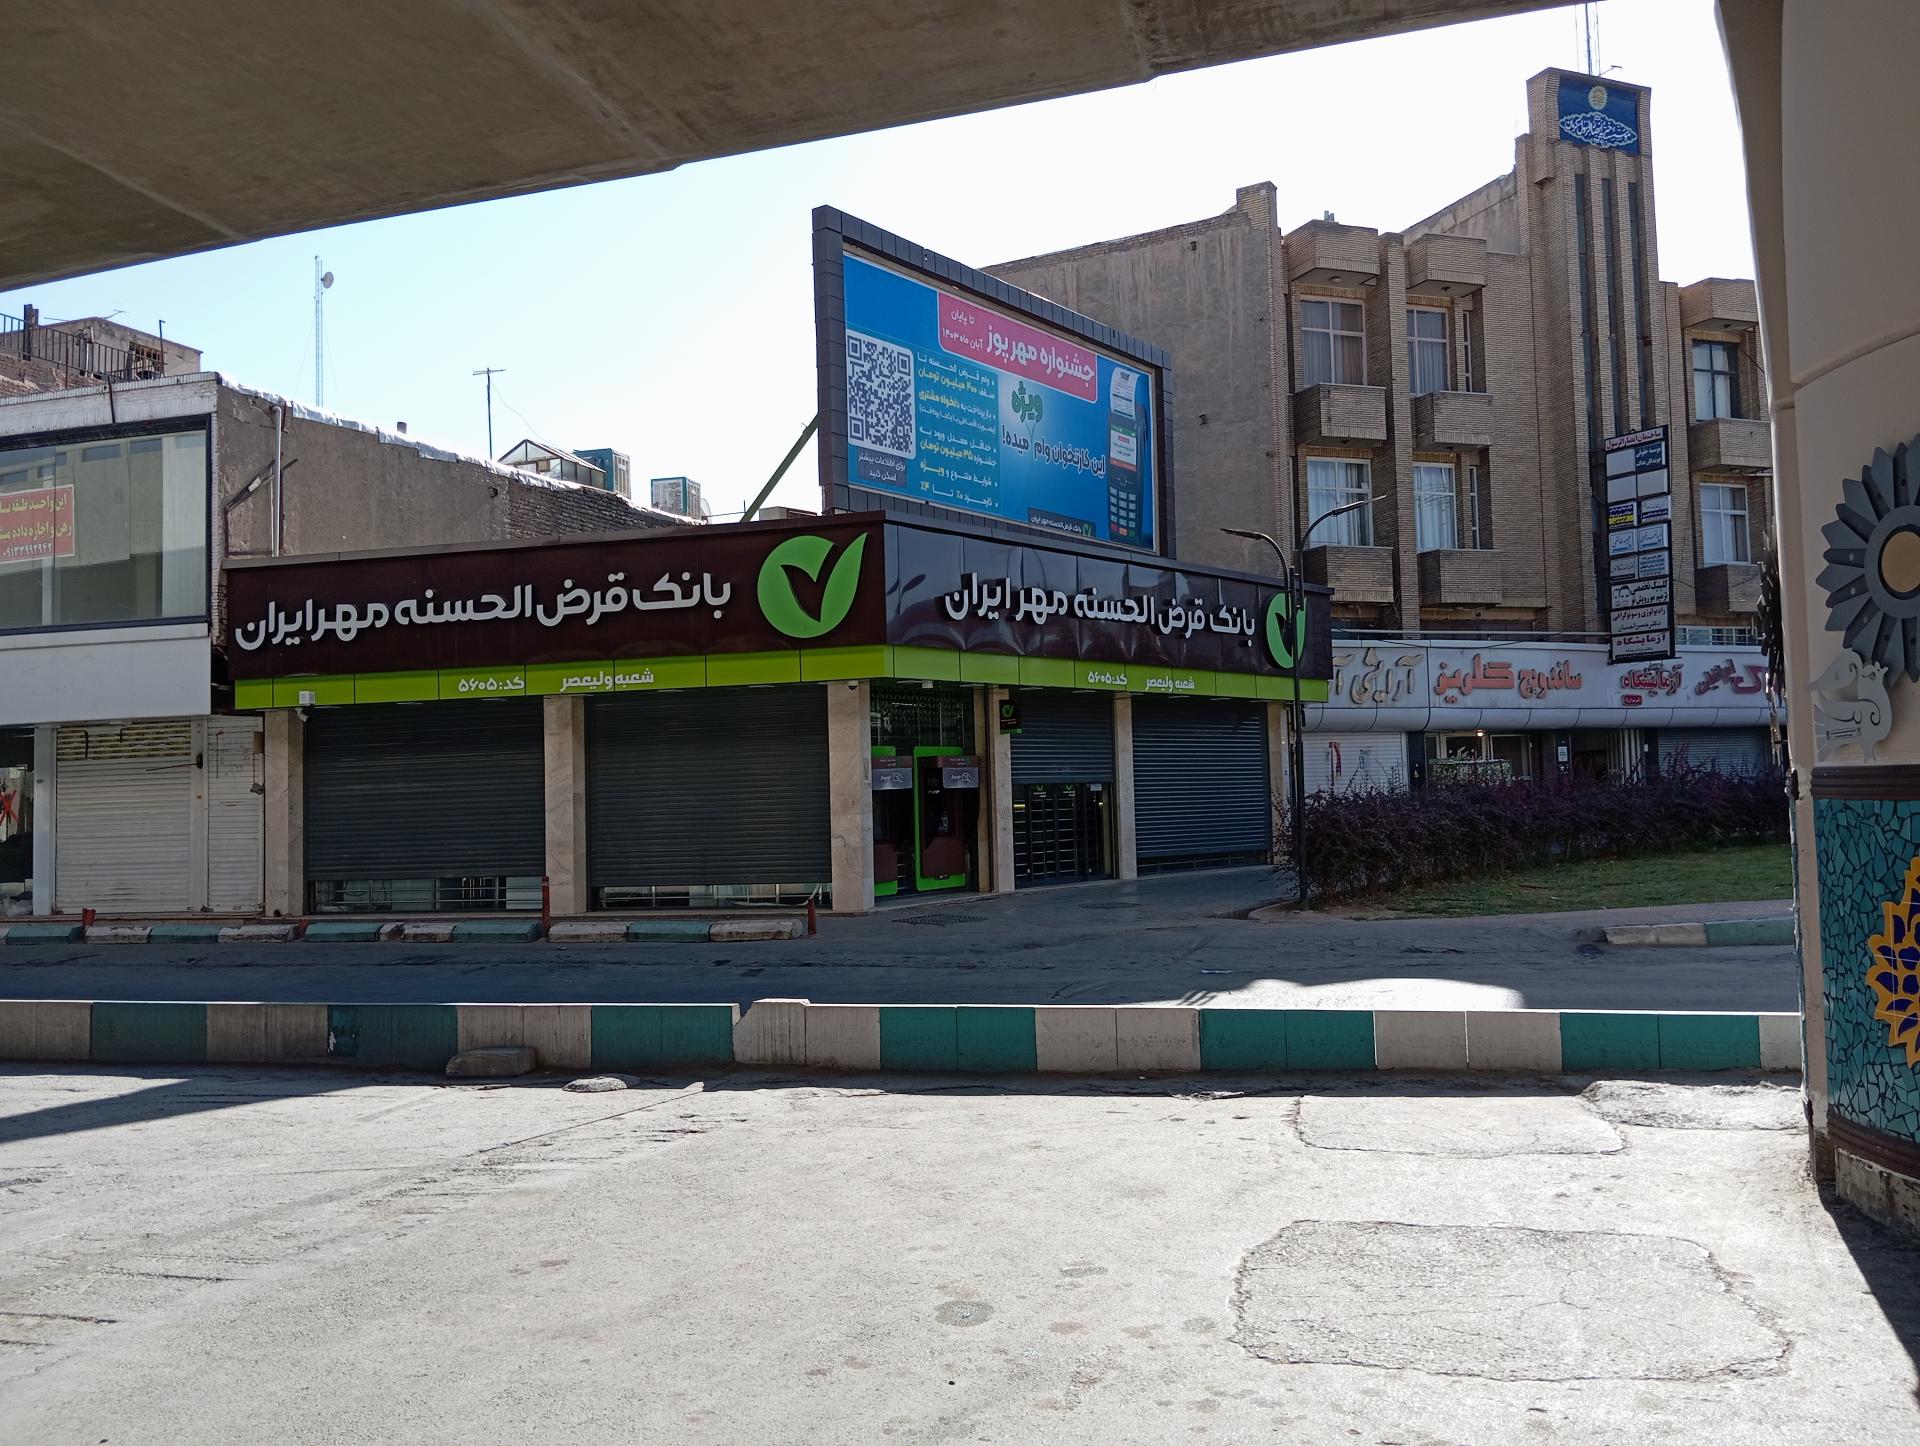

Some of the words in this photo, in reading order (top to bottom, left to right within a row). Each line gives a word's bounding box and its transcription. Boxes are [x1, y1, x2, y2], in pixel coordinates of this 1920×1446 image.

[951, 310, 967, 327] پایان
[968, 314, 975, 324] تا
[942, 328, 960, 341] ۱۴۰۳
[960, 334, 969, 344] ماه
[970, 338, 984, 350] آبان
[986, 325, 1009, 364] پوز
[1010, 338, 1037, 366] مهر
[918, 367, 940, 382] تومان
[1039, 346, 1095, 388] جشنواره
[940, 376, 966, 391] میلیون
[918, 389, 940, 401] مشتری
[1011, 380, 1043, 423] ویژه
[919, 439, 940, 454] تومان
[1001, 424, 1029, 456] میده!
[858, 452, 874, 464] بیشتر
[940, 445, 964, 460] میلیون
[1034, 437, 1051, 464] وام
[1052, 441, 1091, 474] کارتخوان
[874, 456, 896, 467] اطلاعات
[895, 460, 906, 471] برای
[920, 458, 945, 477] ویژه
[1090, 455, 1106, 479] این
[868, 469, 881, 479] کنید
[880, 471, 897, 481] اسکن
[55, 522, 72, 538] رهن
[394, 583, 533, 625] الحسنه
[536, 571, 628, 627] قرض
[632, 571, 731, 619] بانک
[945, 571, 1011, 621] ایران
[1015, 587, 1068, 625] مهر
[1074, 587, 1155, 625] الحسنه
[235, 598, 313, 650] ایران
[311, 602, 390, 642] مهر
[1157, 598, 1205, 639] قرض
[1210, 603, 1256, 648] بانک
[1616, 632, 1666, 646] آزمایشگاه
[458, 675, 526, 693] کد:۵۶۰۵
[560, 670, 613, 693] ولیعصر
[614, 668, 655, 688] شعبه
[1088, 671, 1128, 686] کد:۵۶۰۵
[1145, 675, 1174, 692] ولیعصر
[1174, 677, 1196, 692] شعبه
[1519, 659, 1583, 699] ساندویچ
[1621, 663, 1684, 697] آزمایشگاه
